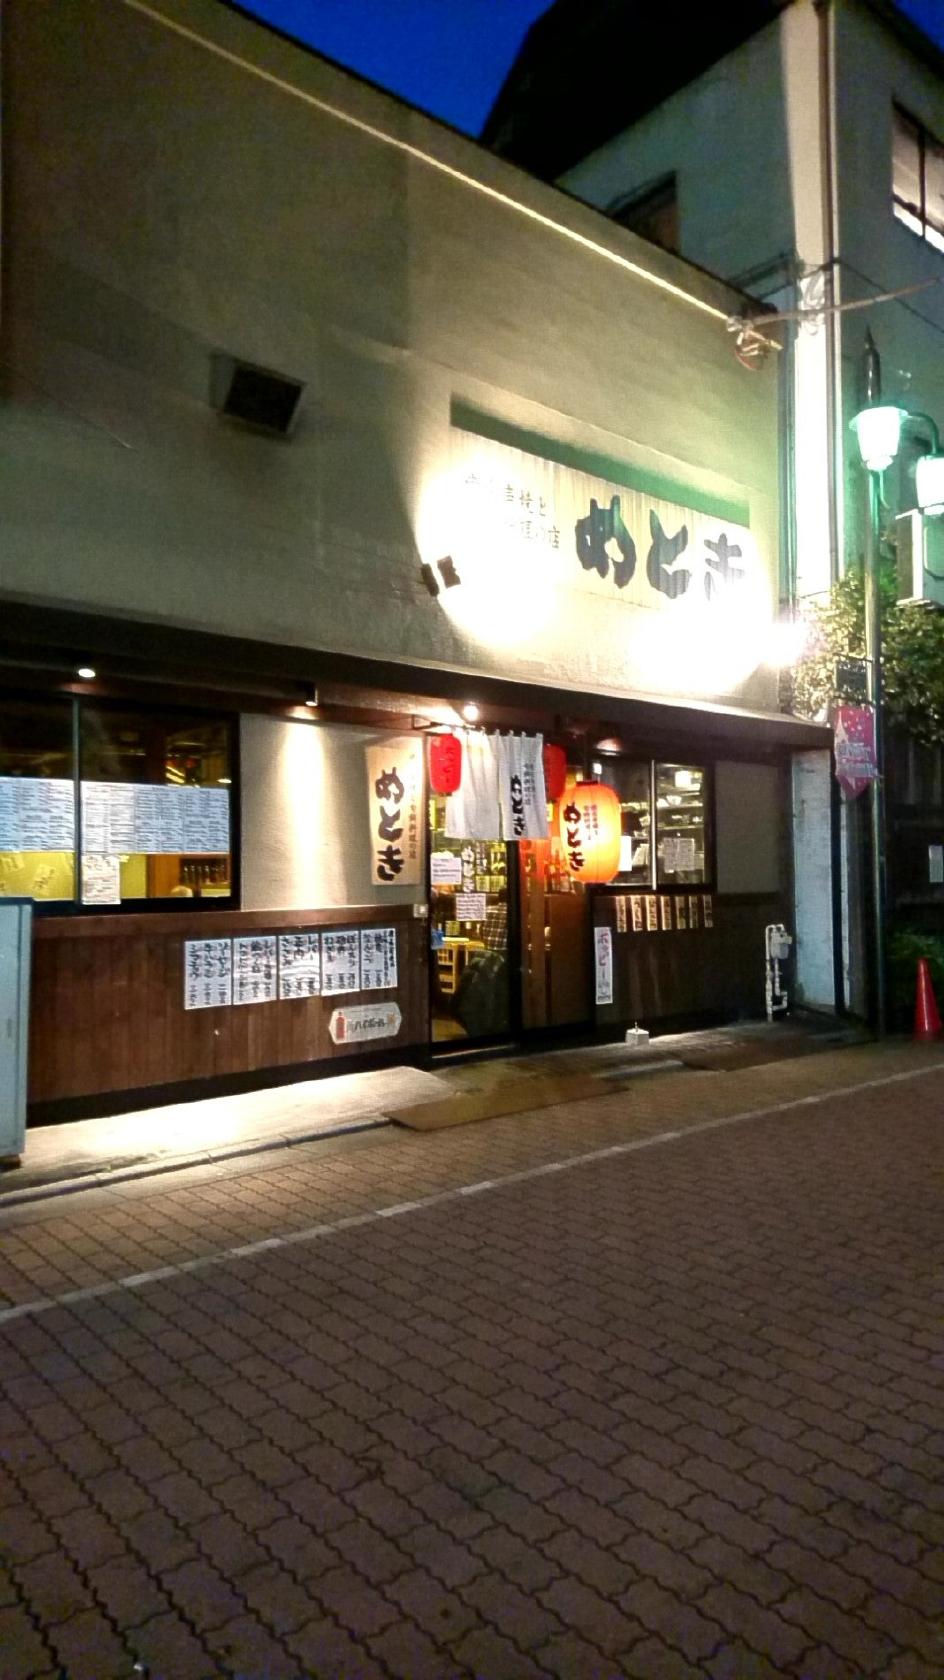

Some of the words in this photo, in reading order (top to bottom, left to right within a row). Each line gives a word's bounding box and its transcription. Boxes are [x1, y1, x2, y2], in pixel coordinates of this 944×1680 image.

[375, 766, 405, 881] めとき
[563, 800, 584, 872] めとき
